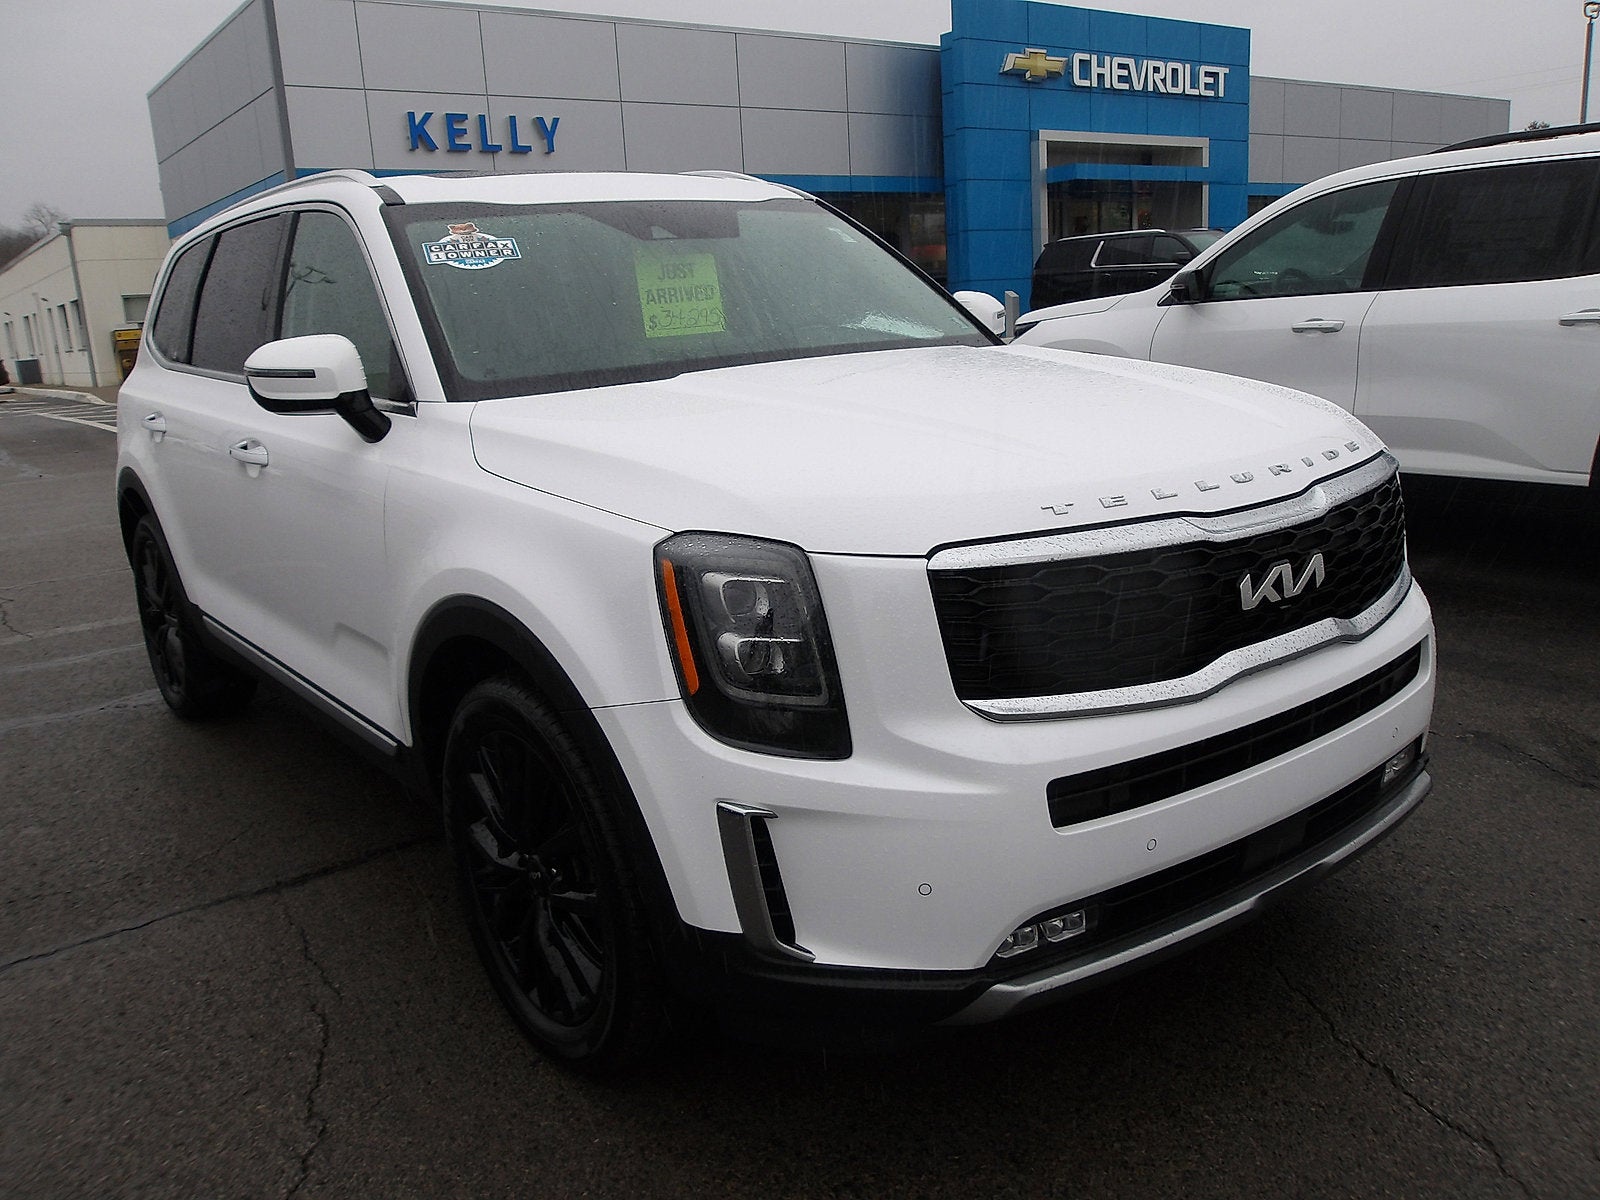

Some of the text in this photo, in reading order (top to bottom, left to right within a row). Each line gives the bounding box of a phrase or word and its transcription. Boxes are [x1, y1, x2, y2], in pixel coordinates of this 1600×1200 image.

[1072, 52, 1230, 98] CHEVROLET
[406, 111, 561, 153] KELLY
[430, 242, 510, 253] CARFAX
[446, 248, 515, 259] OWNER
[658, 262, 696, 281] JUST
[645, 283, 716, 305] ARRIVED
[1041, 440, 1360, 515] TELLURIDE
[1239, 552, 1326, 611] KIA
